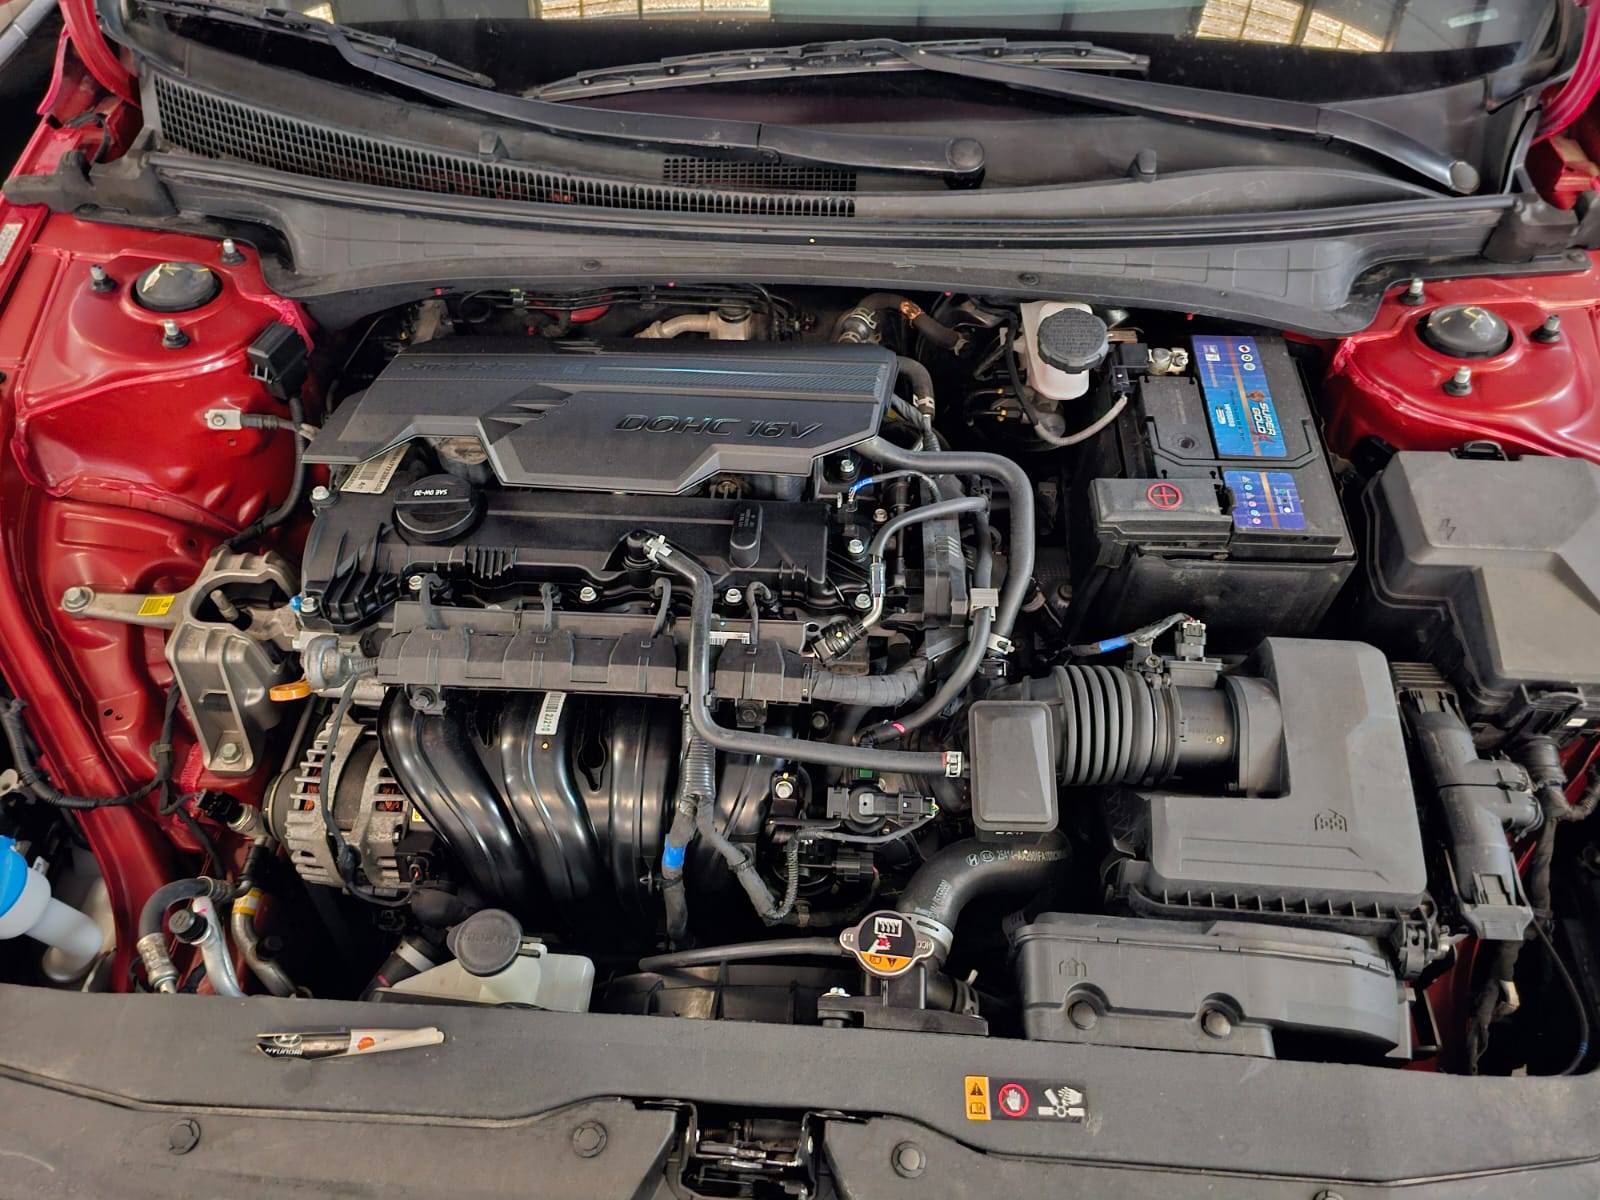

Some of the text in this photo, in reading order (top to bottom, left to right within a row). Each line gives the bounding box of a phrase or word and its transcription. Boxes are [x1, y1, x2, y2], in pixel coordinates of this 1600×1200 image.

[614, 413, 824, 439] DOHC 16V
[1252, 407, 1267, 434] GOLD
[1260, 402, 1277, 437] SUPER
[413, 489, 434, 497] 0W-20
[264, 1047, 303, 1056] HYUNDAI
